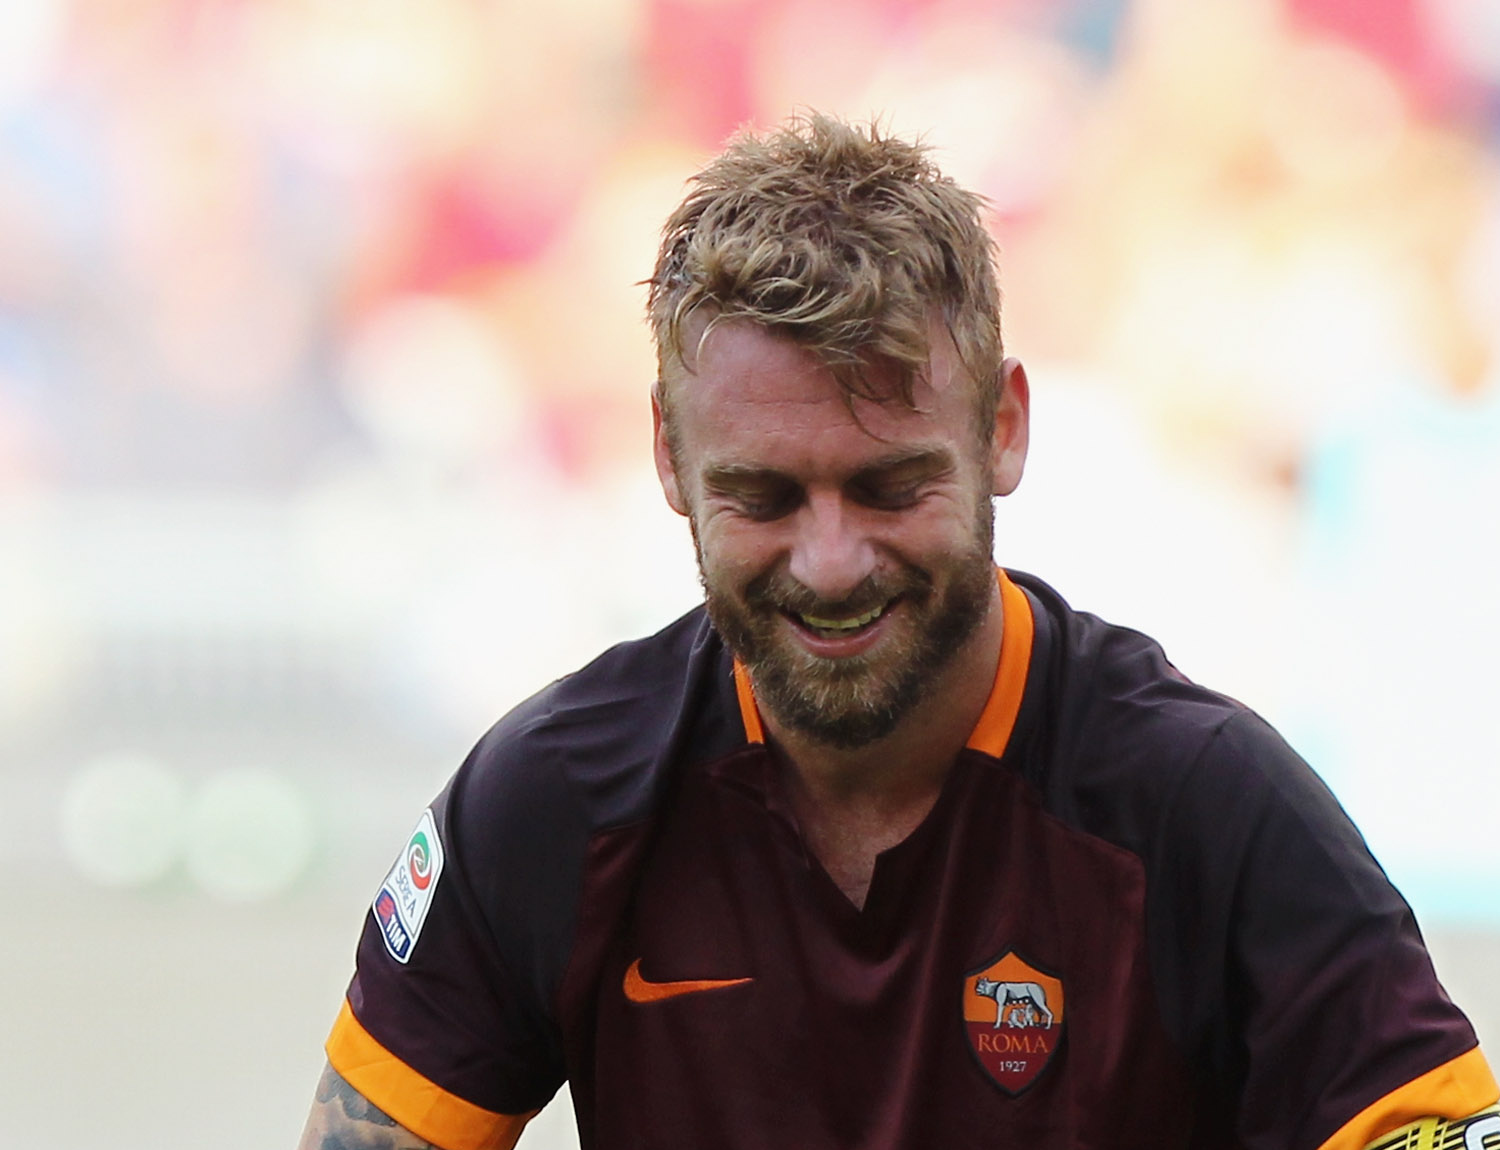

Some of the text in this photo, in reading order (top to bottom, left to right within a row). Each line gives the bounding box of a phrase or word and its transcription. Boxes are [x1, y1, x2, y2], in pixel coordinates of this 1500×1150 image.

[406, 899, 417, 918] A
[386, 914, 407, 952] TIM
[978, 1033, 1050, 1054] ROMA
[999, 1061, 1027, 1072] 1927
